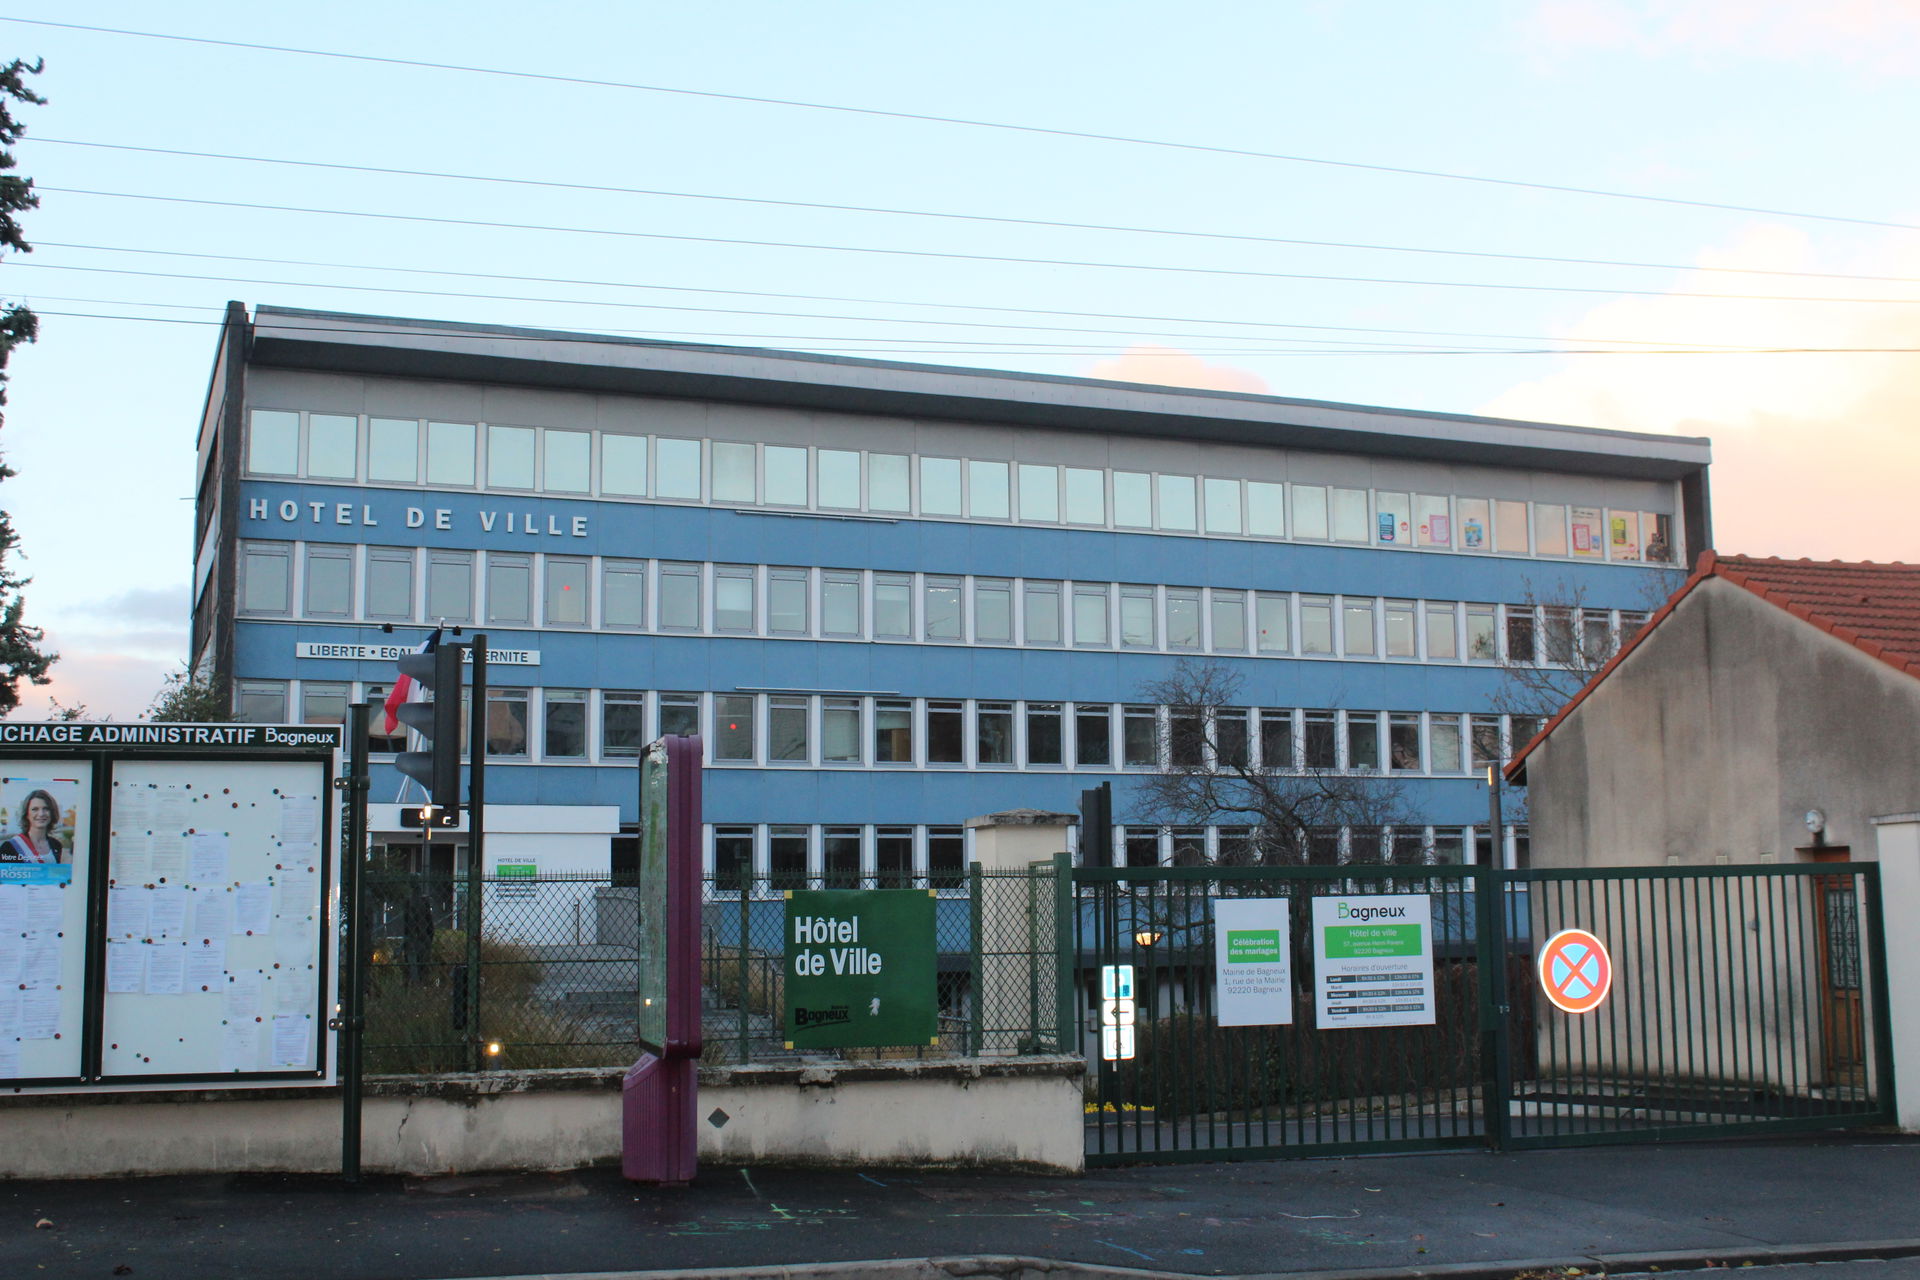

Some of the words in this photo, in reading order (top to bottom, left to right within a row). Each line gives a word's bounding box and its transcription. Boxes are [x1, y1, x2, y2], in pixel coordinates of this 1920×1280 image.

[249, 498, 378, 527] HOTEL
[406, 507, 452, 530] DE
[479, 511, 588, 537] VILLE
[309, 645, 366, 658] LIBERTE
[89, 726, 256, 744] ADMINISTRATIF
[265, 727, 334, 746] Bagneux
[1338, 902, 1406, 922] Bagneux
[795, 915, 858, 944] Hôtel
[1349, 929, 1369, 937] Hôtel
[1233, 938, 1275, 946] Célébration
[1245, 947, 1278, 956] mariages
[795, 948, 825, 976] de
[829, 947, 882, 975] Ville
[1223, 968, 1244, 976] Mairie
[1257, 968, 1285, 976] Bagneux
[1227, 986, 1252, 994] 92220
[1253, 986, 1282, 995] Bagneux
[795, 1008, 848, 1025] Bagneux
